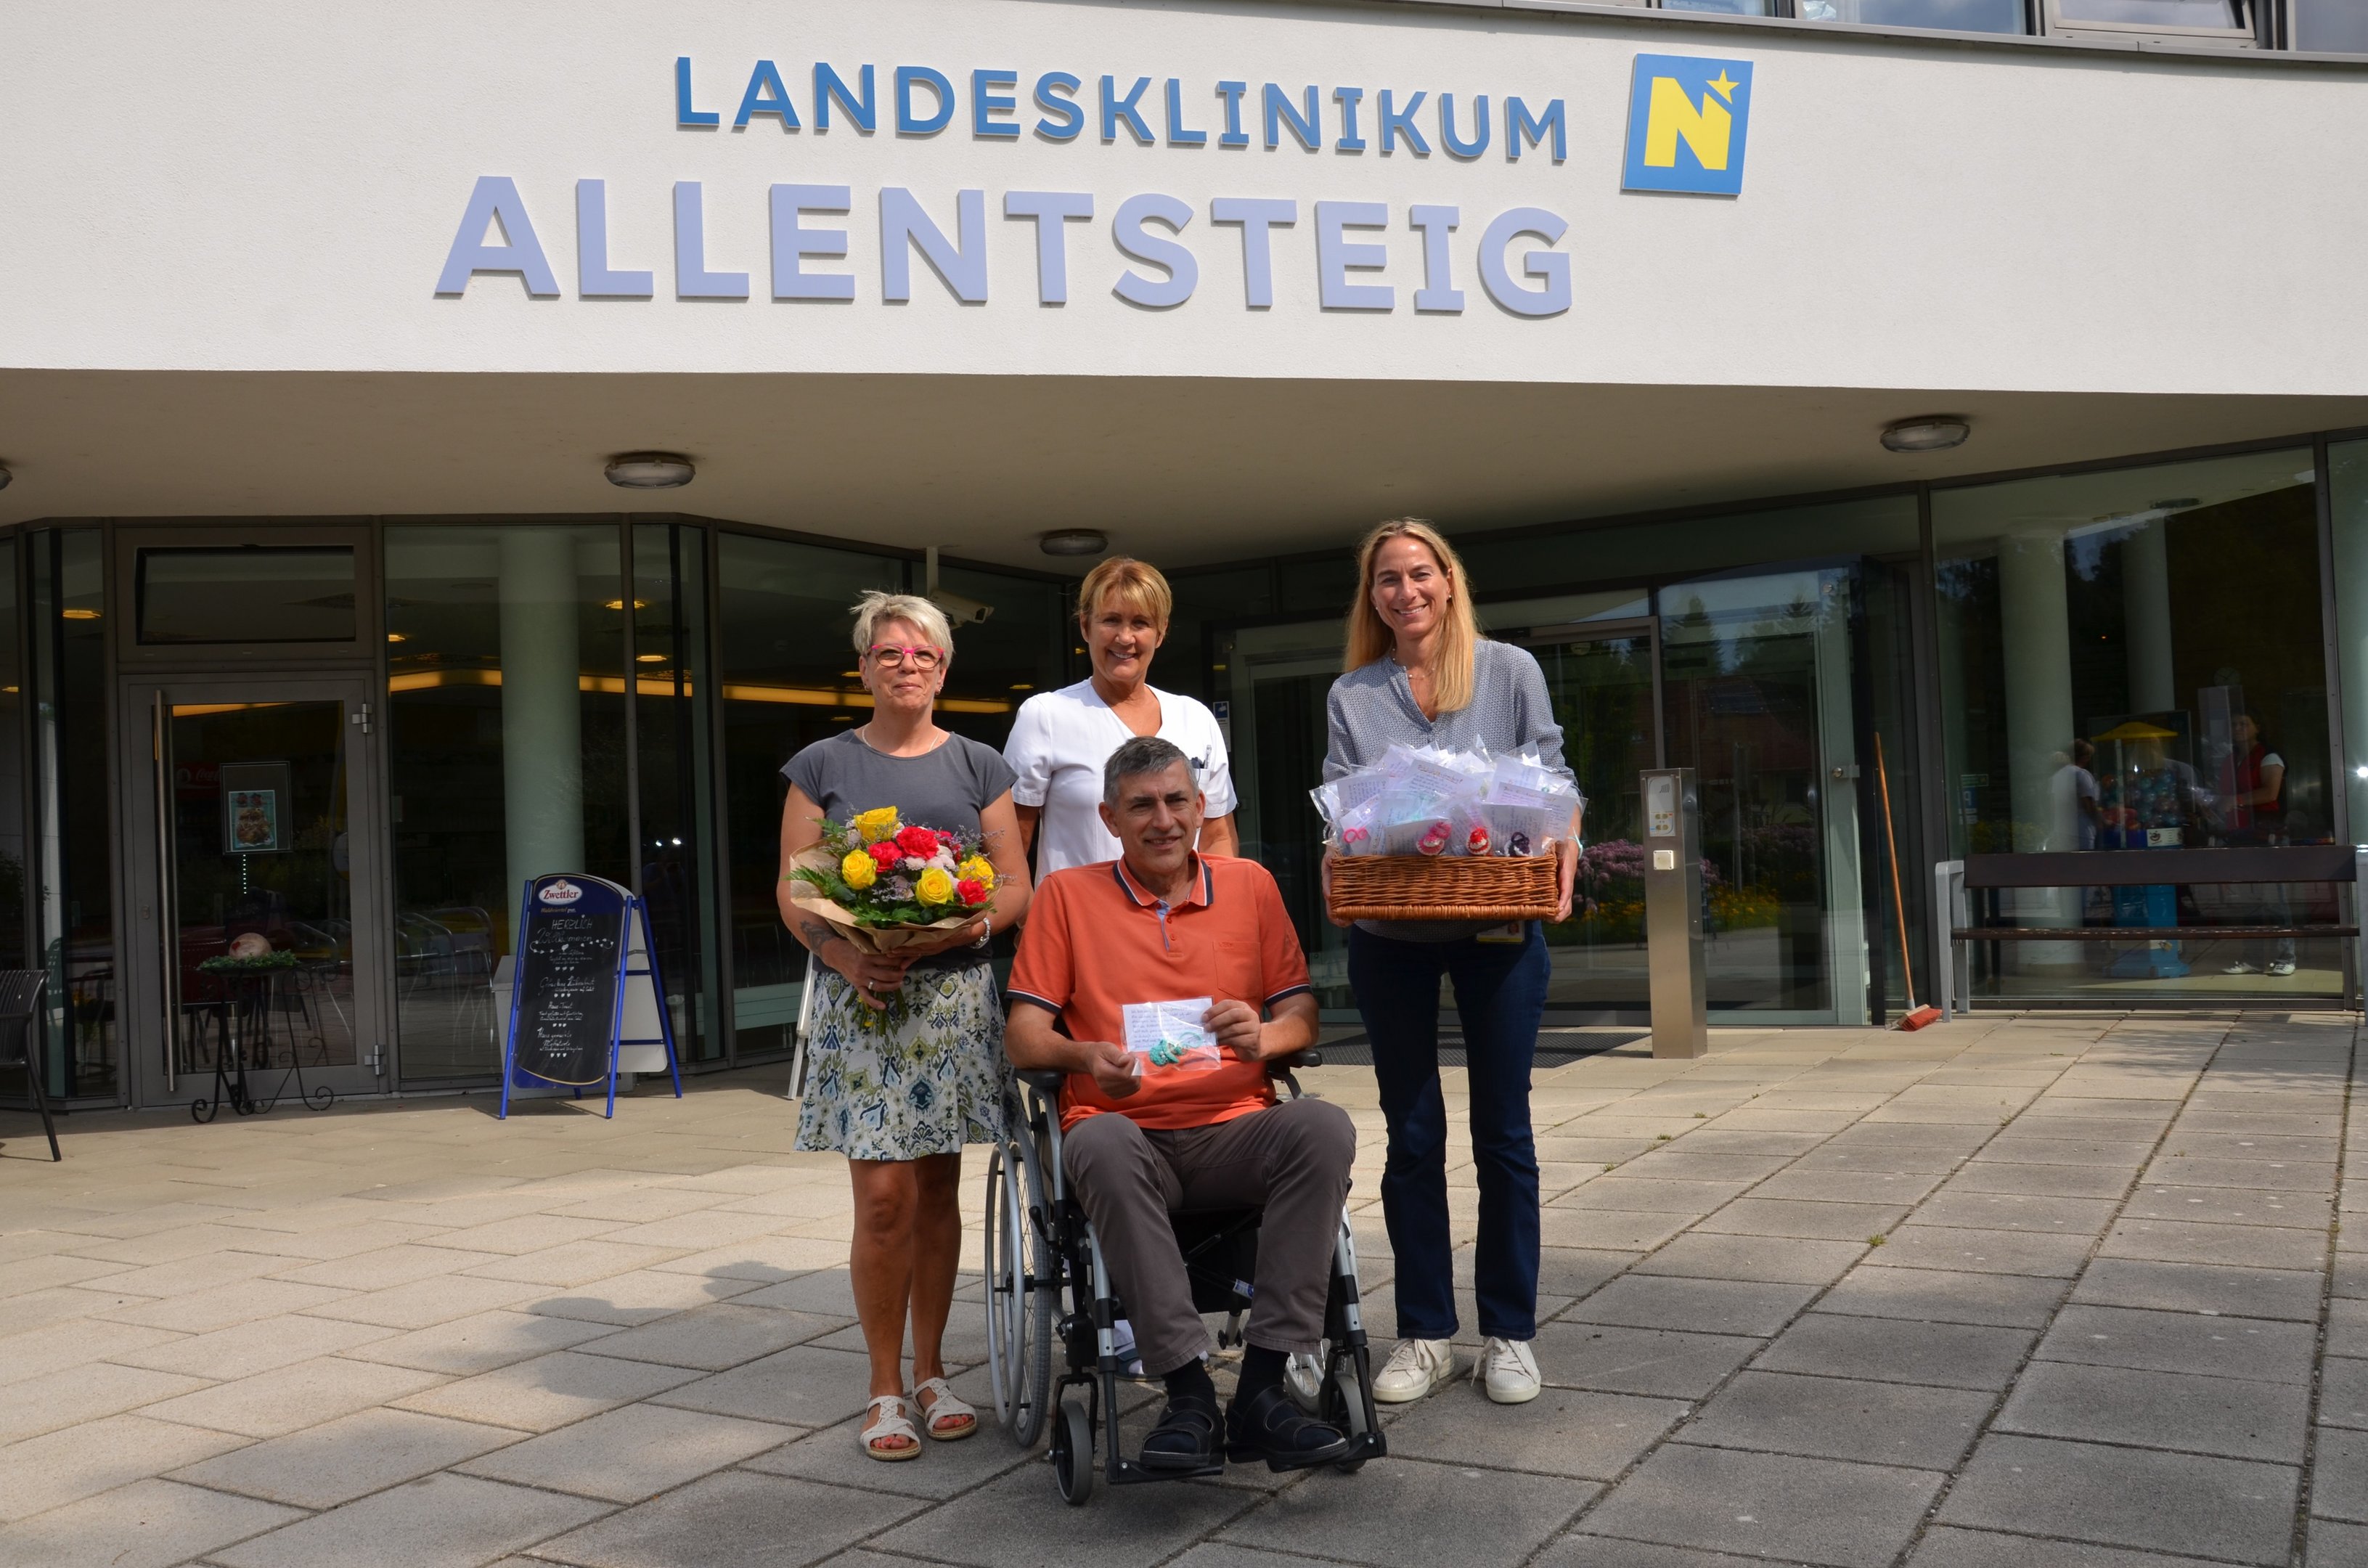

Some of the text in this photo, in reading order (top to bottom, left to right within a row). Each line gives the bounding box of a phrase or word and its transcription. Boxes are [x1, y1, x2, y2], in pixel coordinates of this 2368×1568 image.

[676, 57, 1567, 162] LANDESKLINIKUM
[434, 176, 1573, 317] ALLENTSTEIG
[543, 889, 579, 900] Zwettler
[552, 918, 593, 930] HERZLICH
